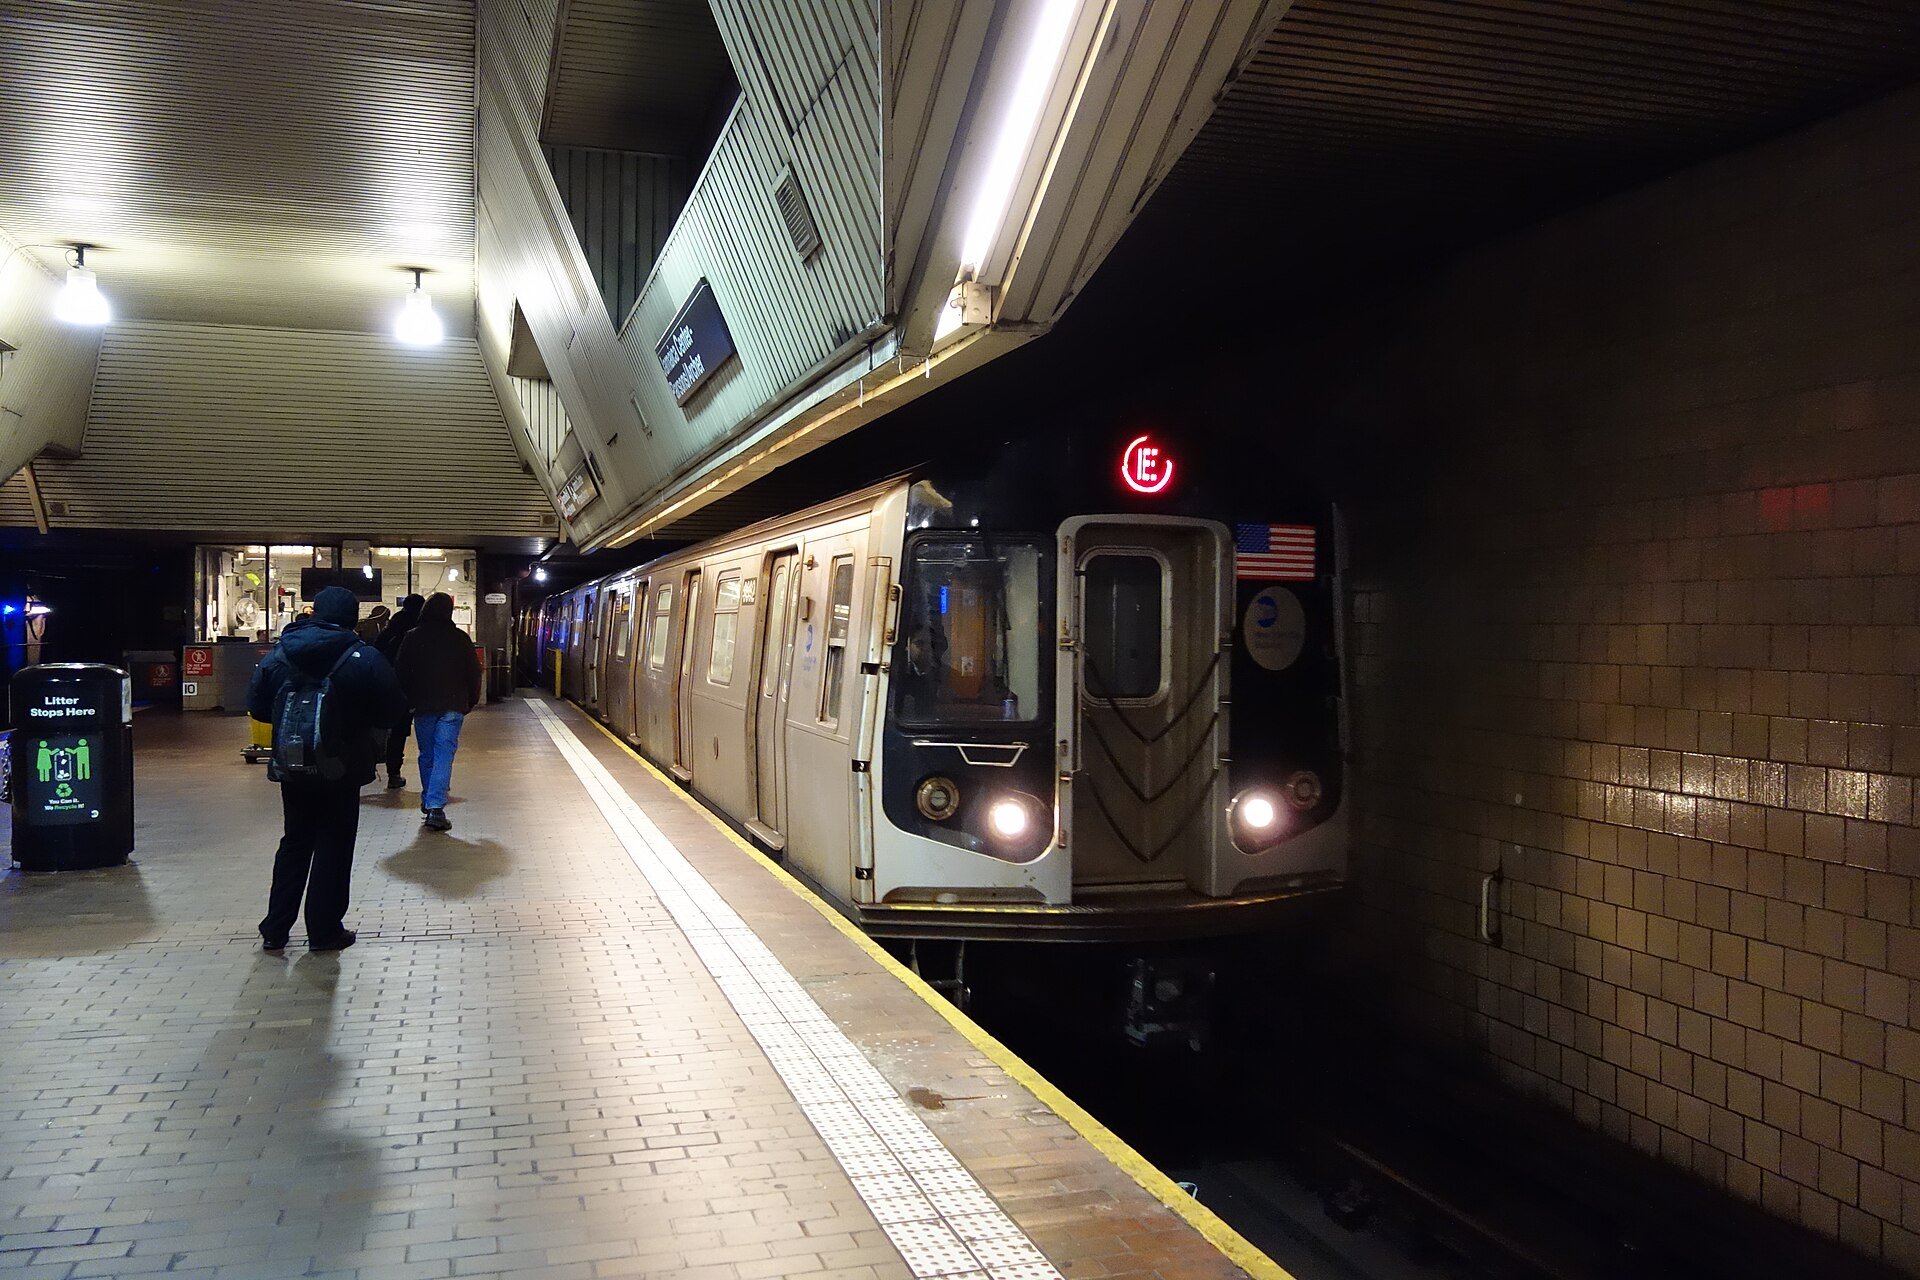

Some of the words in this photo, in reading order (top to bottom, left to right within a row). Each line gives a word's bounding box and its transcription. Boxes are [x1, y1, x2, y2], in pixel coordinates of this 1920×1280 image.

[659, 345, 680, 377] Jamaica
[1137, 448, 1158, 481] E
[184, 684, 195, 694] 10
[44, 696, 79, 705] Litter
[30, 708, 64, 718] Stops
[65, 707, 96, 716] Here
